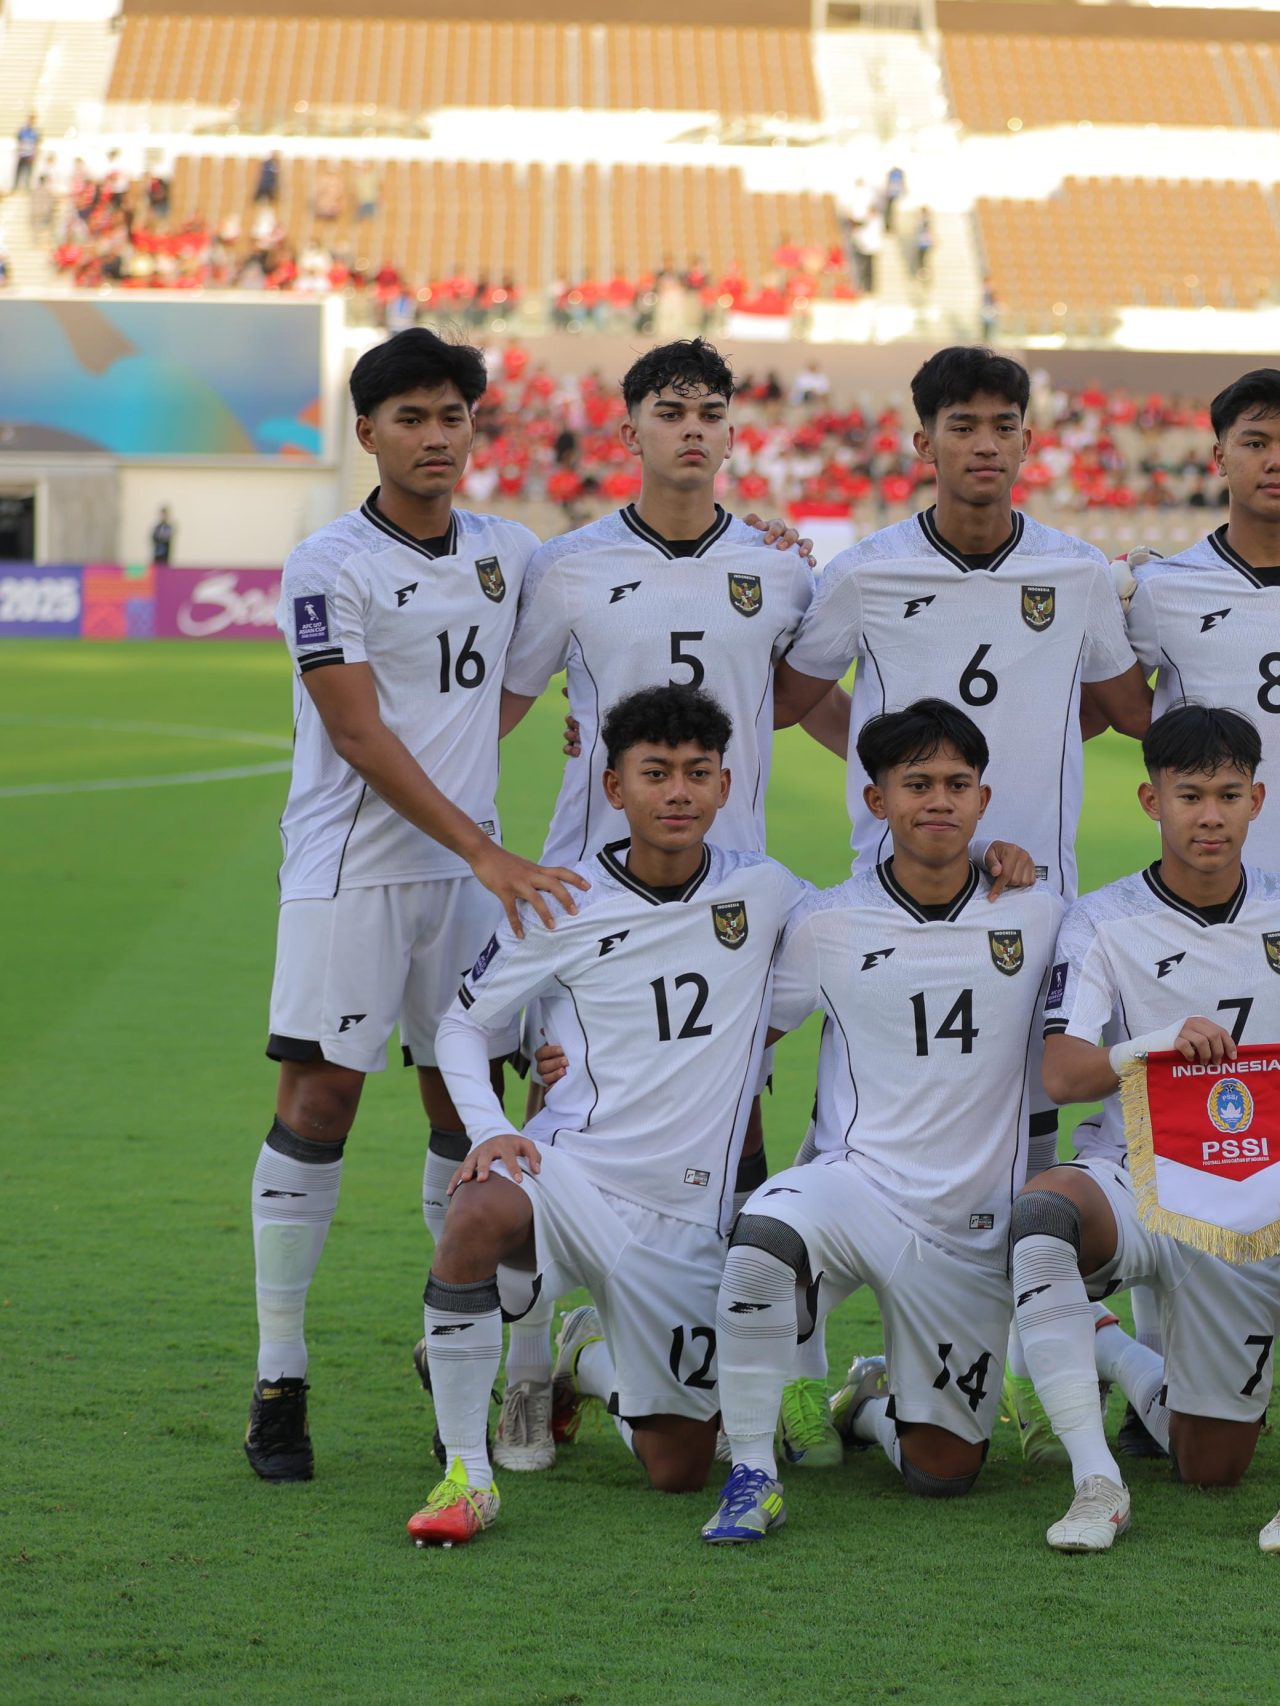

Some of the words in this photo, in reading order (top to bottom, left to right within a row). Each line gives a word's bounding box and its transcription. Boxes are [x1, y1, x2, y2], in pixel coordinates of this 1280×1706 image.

[436, 625, 486, 694] 16
[669, 630, 705, 693] 5
[958, 643, 998, 707] 6
[649, 972, 713, 1042] 12
[909, 988, 980, 1057] 14
[1216, 997, 1254, 1047] 7
[1202, 1137, 1269, 1161] PSSI
[669, 1324, 718, 1390] 12
[932, 1342, 992, 1412] 14
[1239, 1334, 1273, 1397] 7
